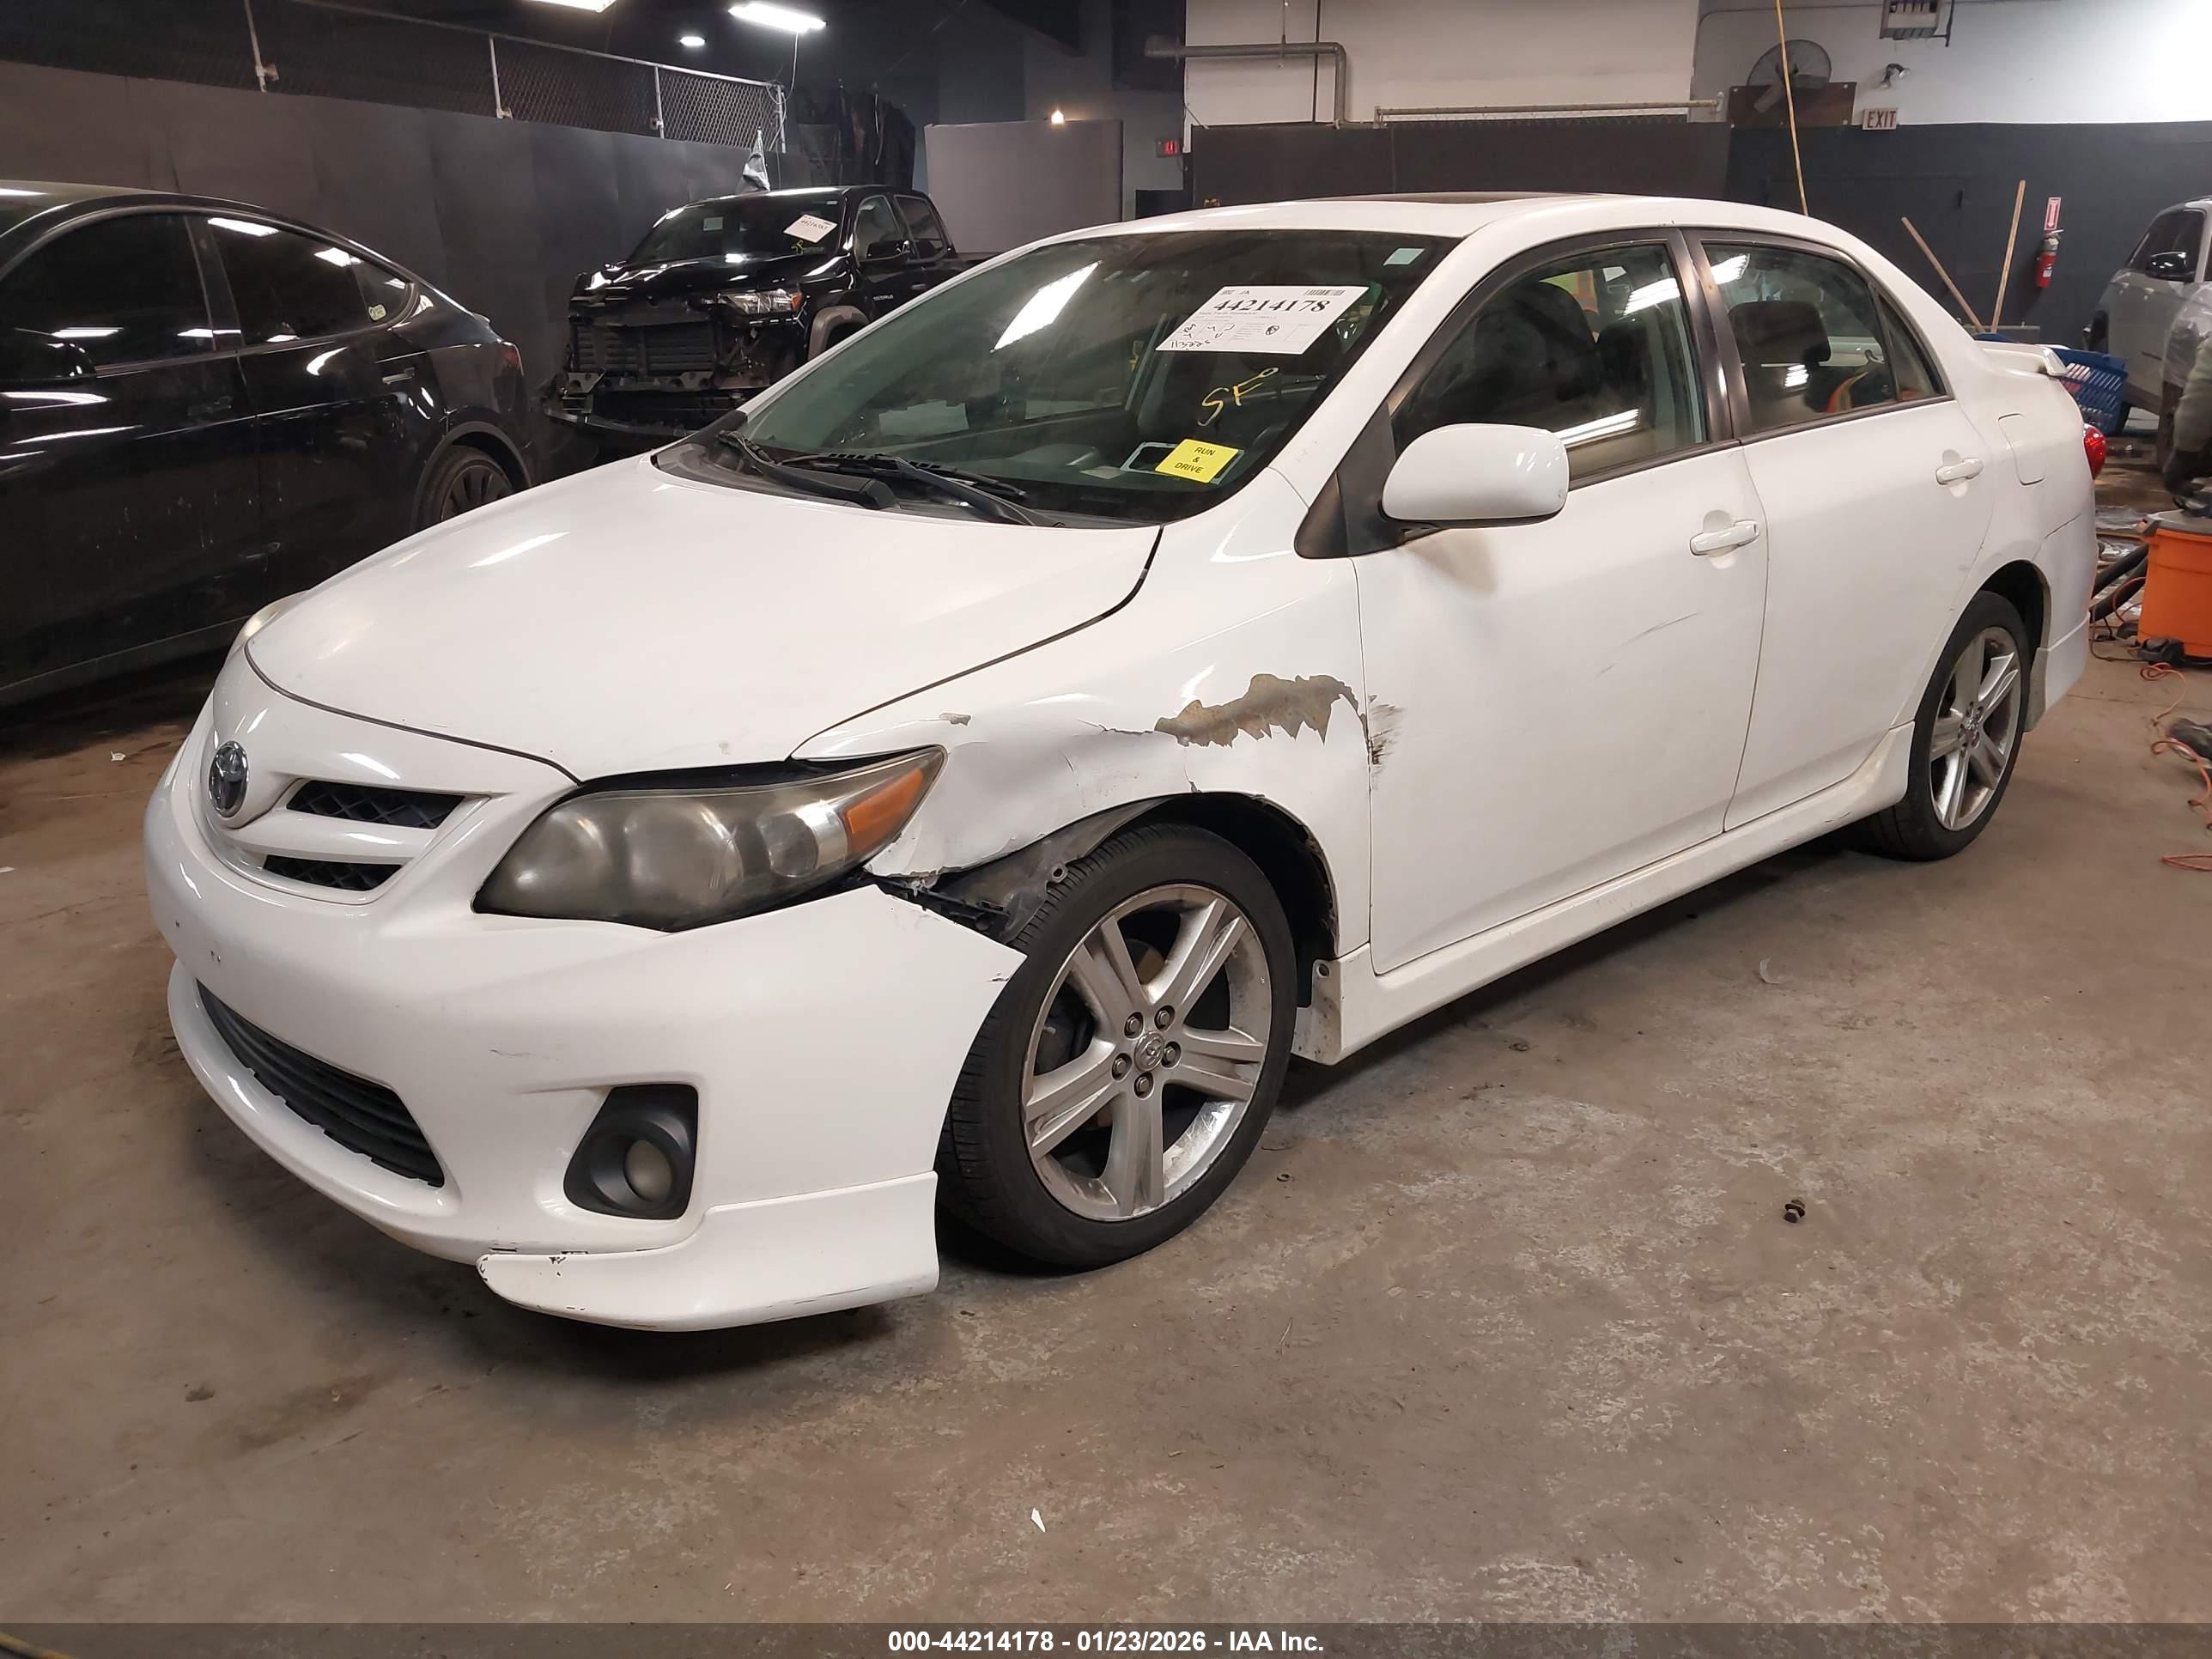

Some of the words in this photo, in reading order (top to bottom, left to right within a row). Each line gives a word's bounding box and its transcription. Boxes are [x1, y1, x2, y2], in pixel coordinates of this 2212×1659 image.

[1868, 111, 1897, 128] EXIT
[1213, 299, 1330, 313] 44214178
[1194, 447, 1216, 456] RUN
[1174, 462, 1204, 474] DRIVE
